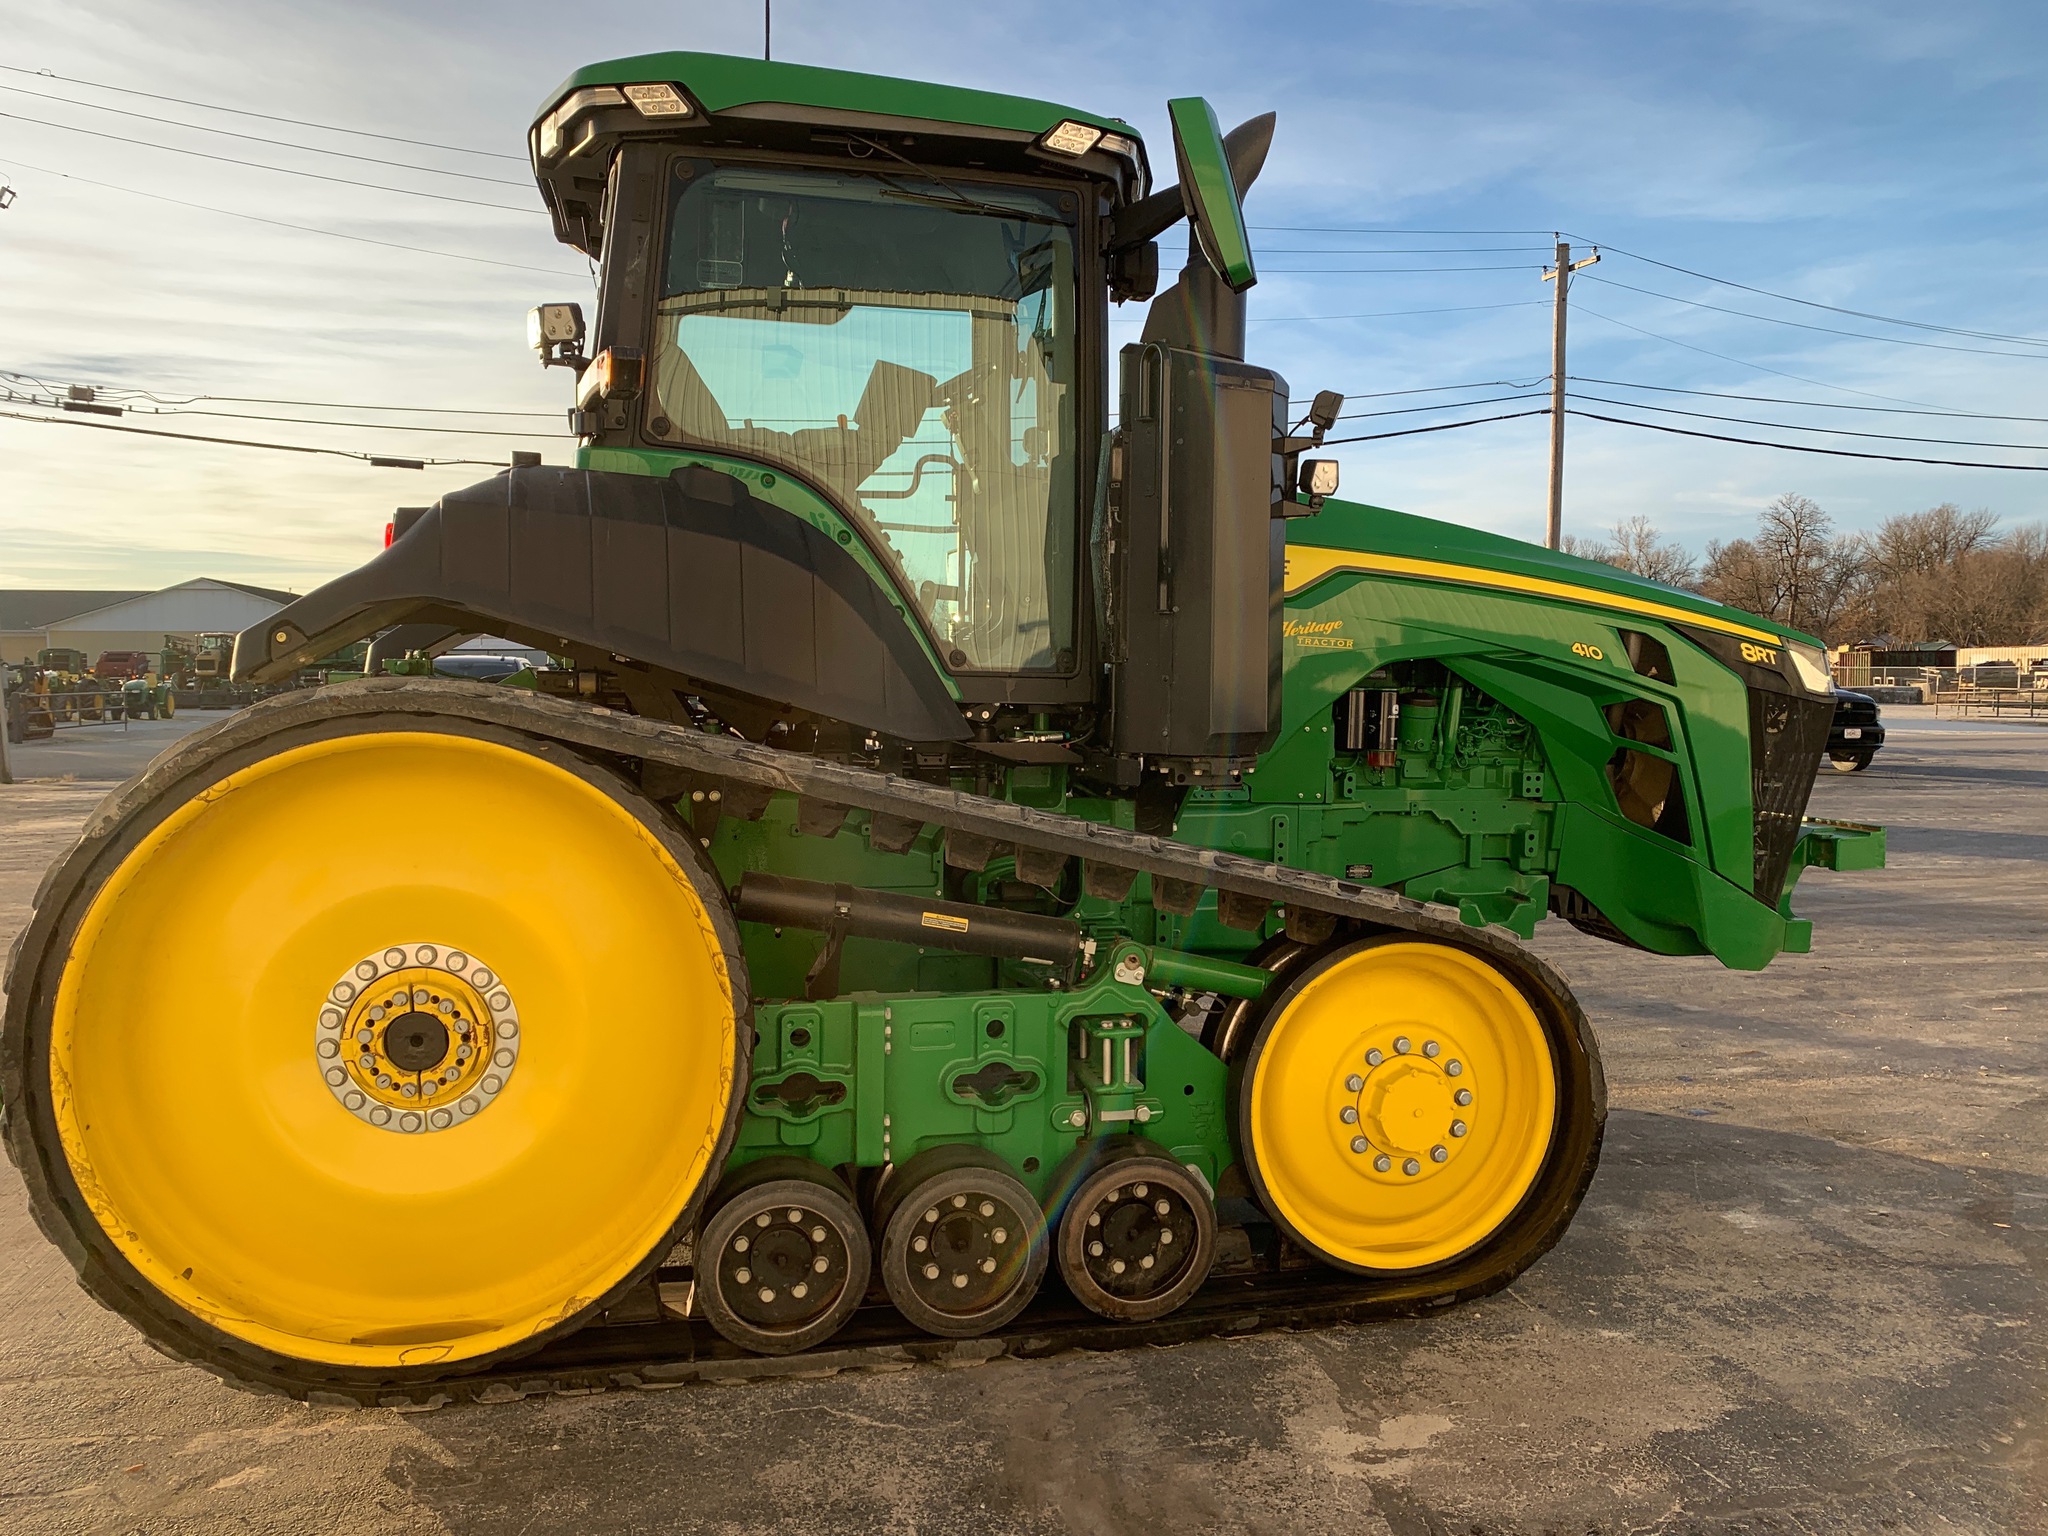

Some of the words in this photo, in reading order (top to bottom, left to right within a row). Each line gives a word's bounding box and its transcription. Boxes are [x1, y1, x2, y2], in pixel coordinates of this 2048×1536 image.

[1283, 619, 1344, 637] Heritage
[1298, 637, 1354, 648] TRACTOR
[1571, 642, 1604, 660] 410
[1740, 642, 1777, 665] 8RT
